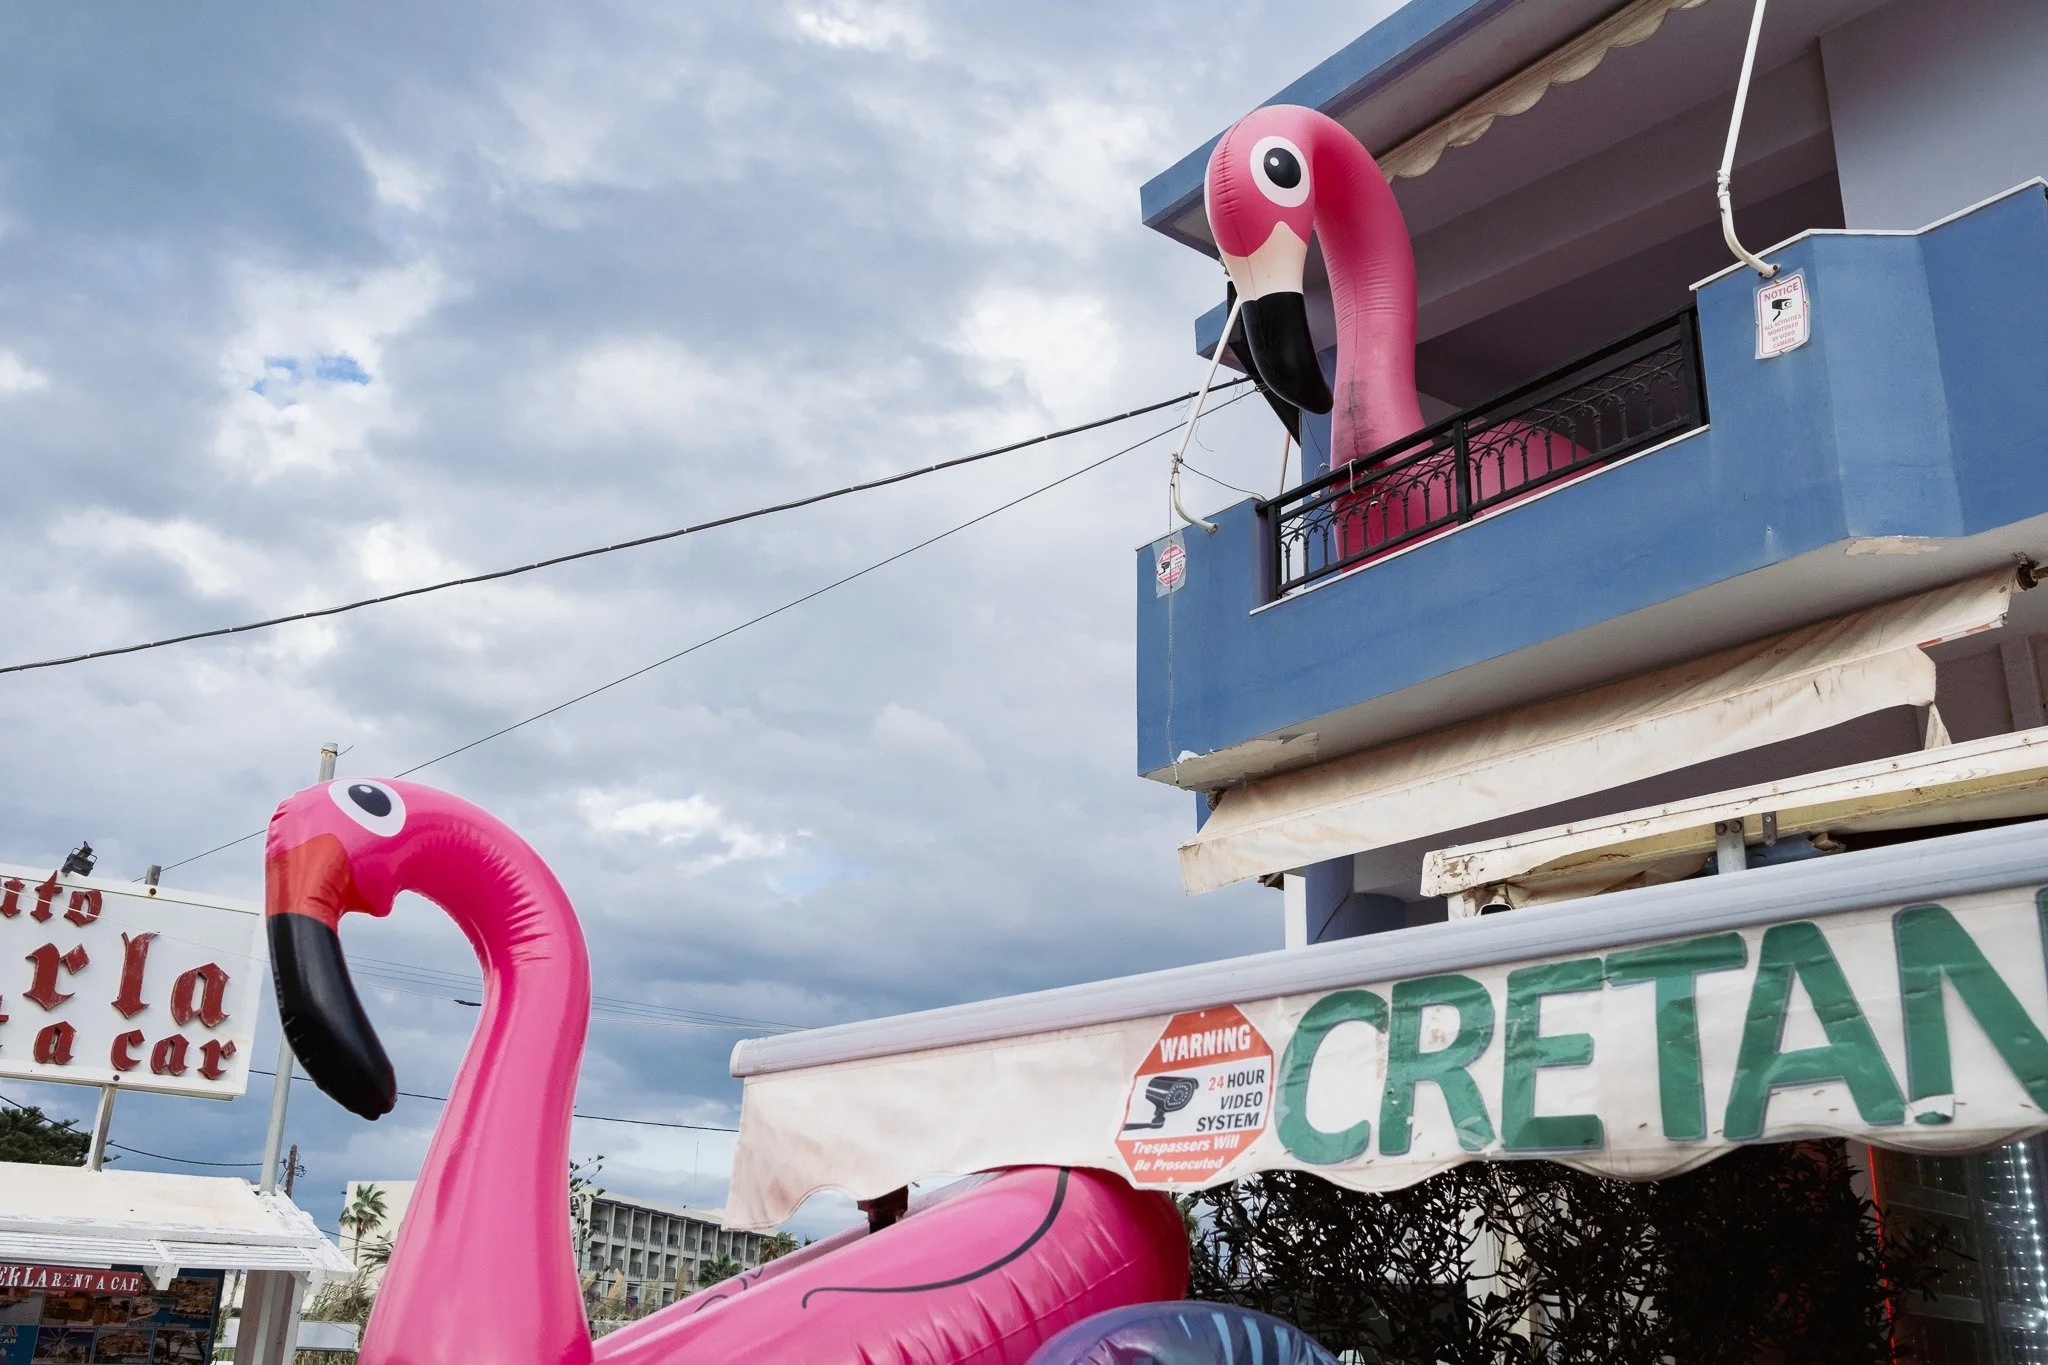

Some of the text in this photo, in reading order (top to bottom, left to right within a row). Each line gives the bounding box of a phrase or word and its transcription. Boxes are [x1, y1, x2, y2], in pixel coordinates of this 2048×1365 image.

[1764, 283, 1798, 301] NOTICE
[34, 1021, 77, 1065] a
[111, 1029, 237, 1080] car
[1160, 1024, 1251, 1063] WARNING
[1208, 1069, 1265, 1091] 24 HOUR
[1220, 1091, 1263, 1110] VIDEO
[1196, 1112, 1260, 1132] SYSTEM
[1132, 1134, 1240, 1155] Trespassers Will
[1134, 1156, 1224, 1171] Be Prosecuted
[96, 1276, 105, 1290] A
